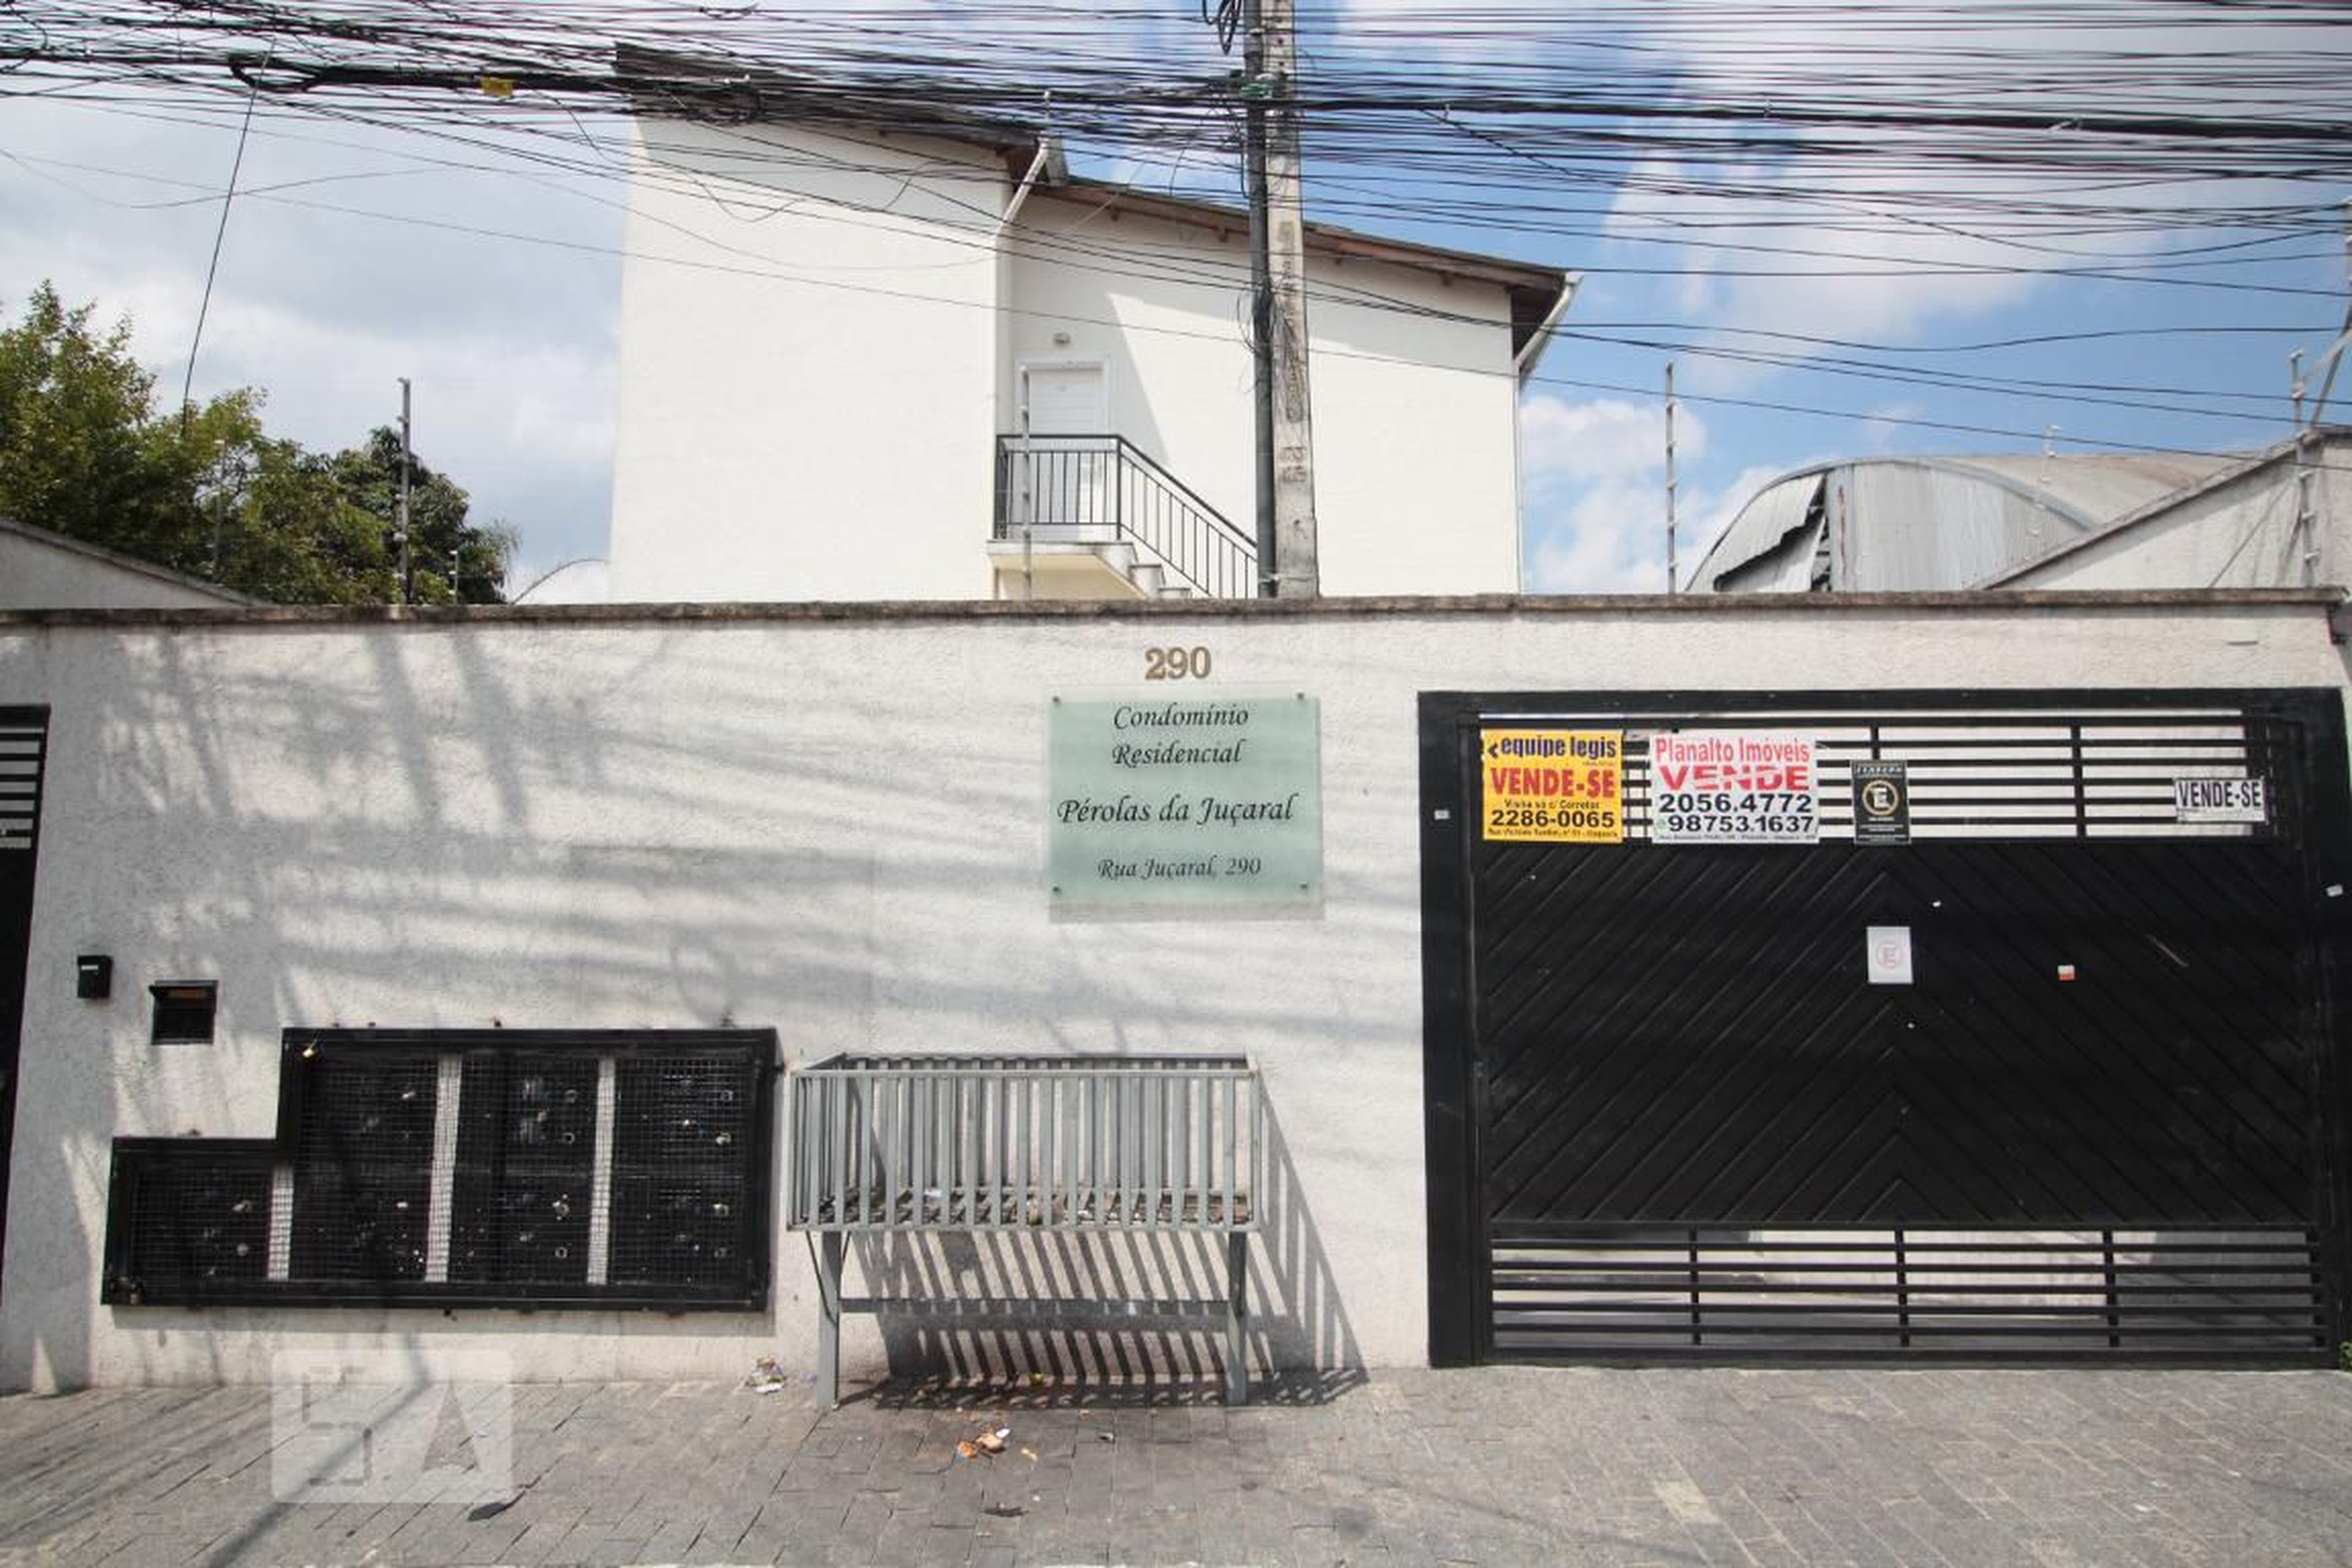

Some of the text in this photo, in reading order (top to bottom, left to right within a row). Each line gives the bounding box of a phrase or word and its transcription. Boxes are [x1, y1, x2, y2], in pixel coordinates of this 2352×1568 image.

[1145, 646, 1212, 680] 290
[1112, 739, 1246, 768] Residencial
[1501, 736, 1617, 760] equipe legis
[1656, 736, 1811, 762] Planalto Imóveis
[1490, 767, 1615, 797] VENDE-SE
[1659, 765, 1810, 791] VENDE
[1659, 793, 1812, 813] 2056.4772
[2178, 781, 2261, 807] VENDE-SE
[1057, 793, 1298, 826] Pérolas da Juçaral
[1491, 810, 1615, 828] 2286-0065
[1668, 815, 1814, 832] 98753.1637
[1098, 858, 1136, 880] Rua
[1224, 857, 1262, 876] 290
